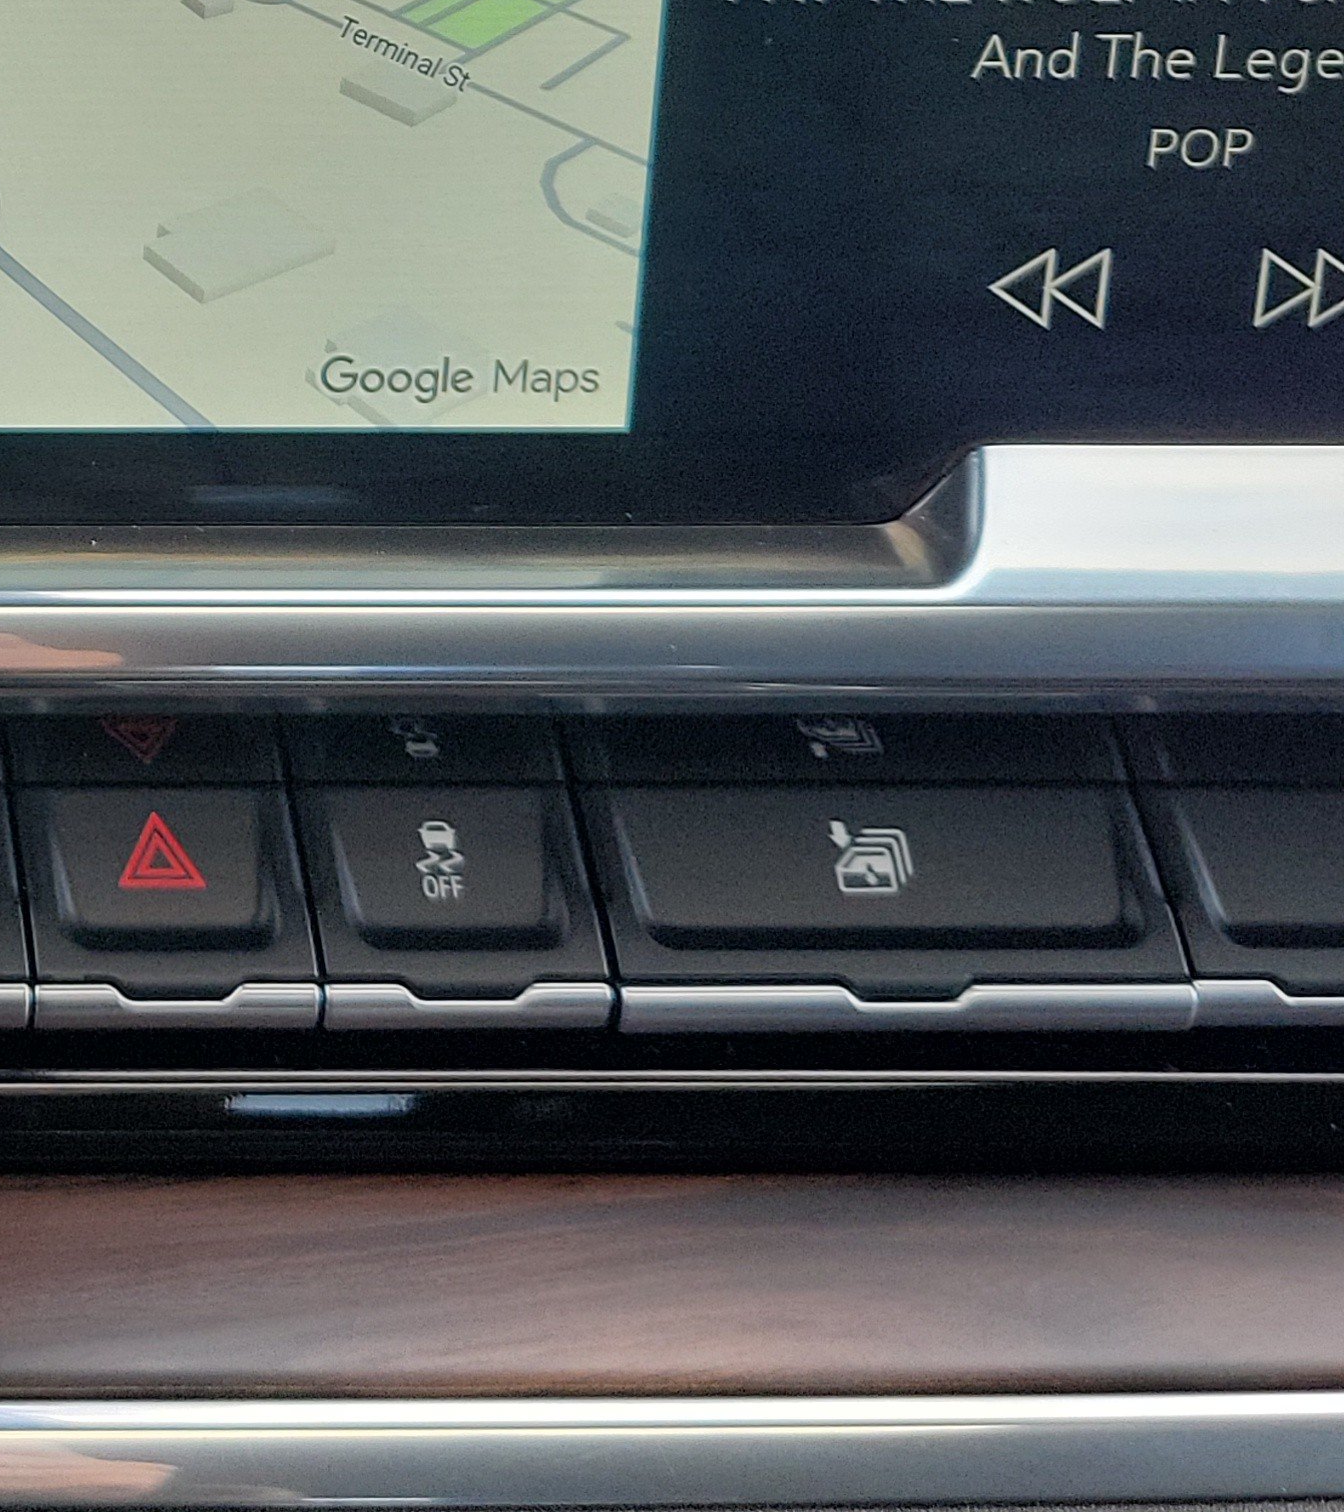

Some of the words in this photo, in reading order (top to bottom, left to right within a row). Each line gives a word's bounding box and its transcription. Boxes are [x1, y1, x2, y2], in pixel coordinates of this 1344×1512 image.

[338, 14, 443, 79] Terminal
[442, 63, 472, 93] St
[970, 31, 1081, 81] And
[1095, 31, 1198, 81] The
[1145, 128, 1255, 170] POP
[320, 355, 474, 405] Google
[492, 358, 601, 402] Maps
[422, 875, 464, 899] OFF
